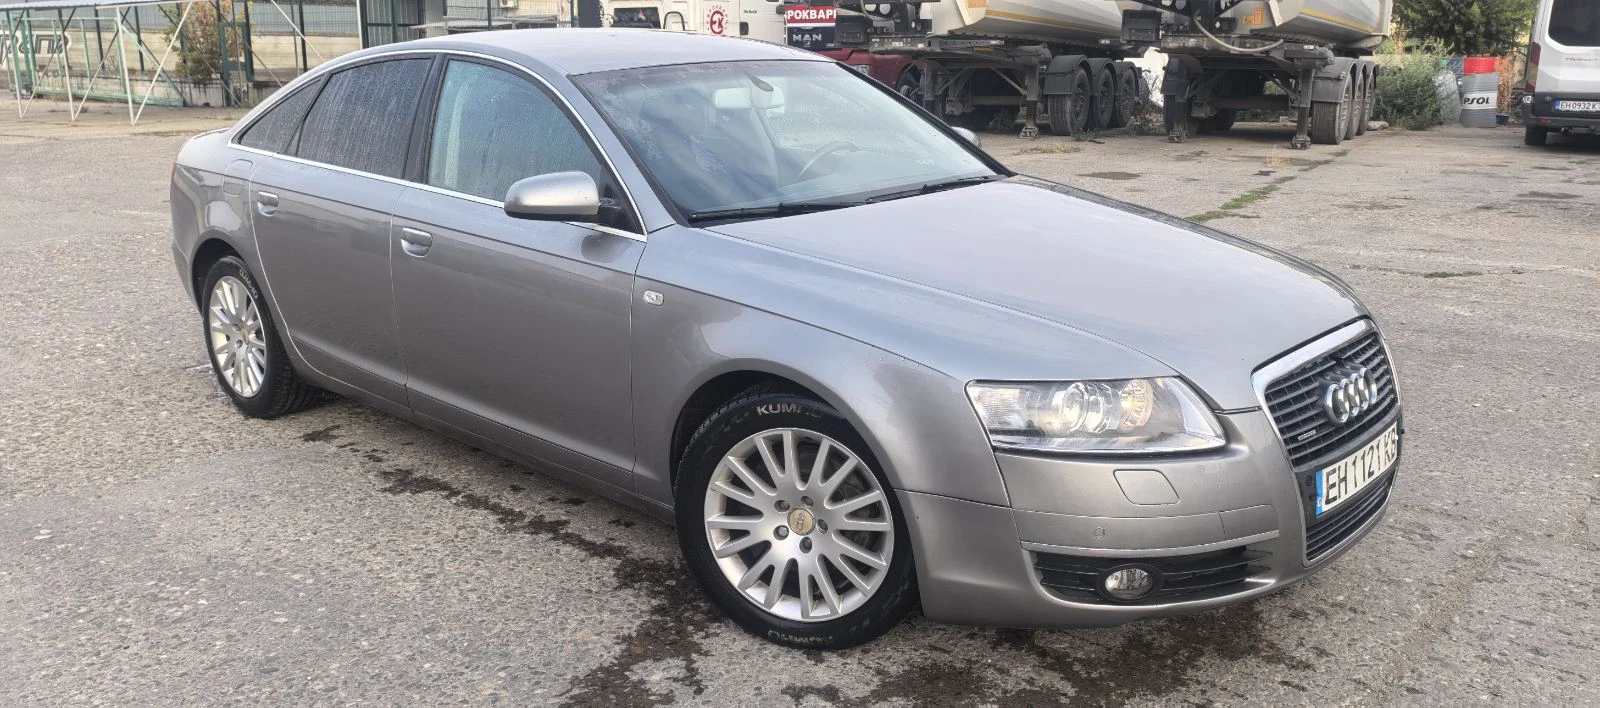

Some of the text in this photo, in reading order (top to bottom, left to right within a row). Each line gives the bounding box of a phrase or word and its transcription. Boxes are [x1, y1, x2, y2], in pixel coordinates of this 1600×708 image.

[792, 33, 822, 41] MAN
[1572, 102, 1591, 110] 0932
[1324, 461, 1348, 505] EH
[1352, 438, 1381, 488] 1121
